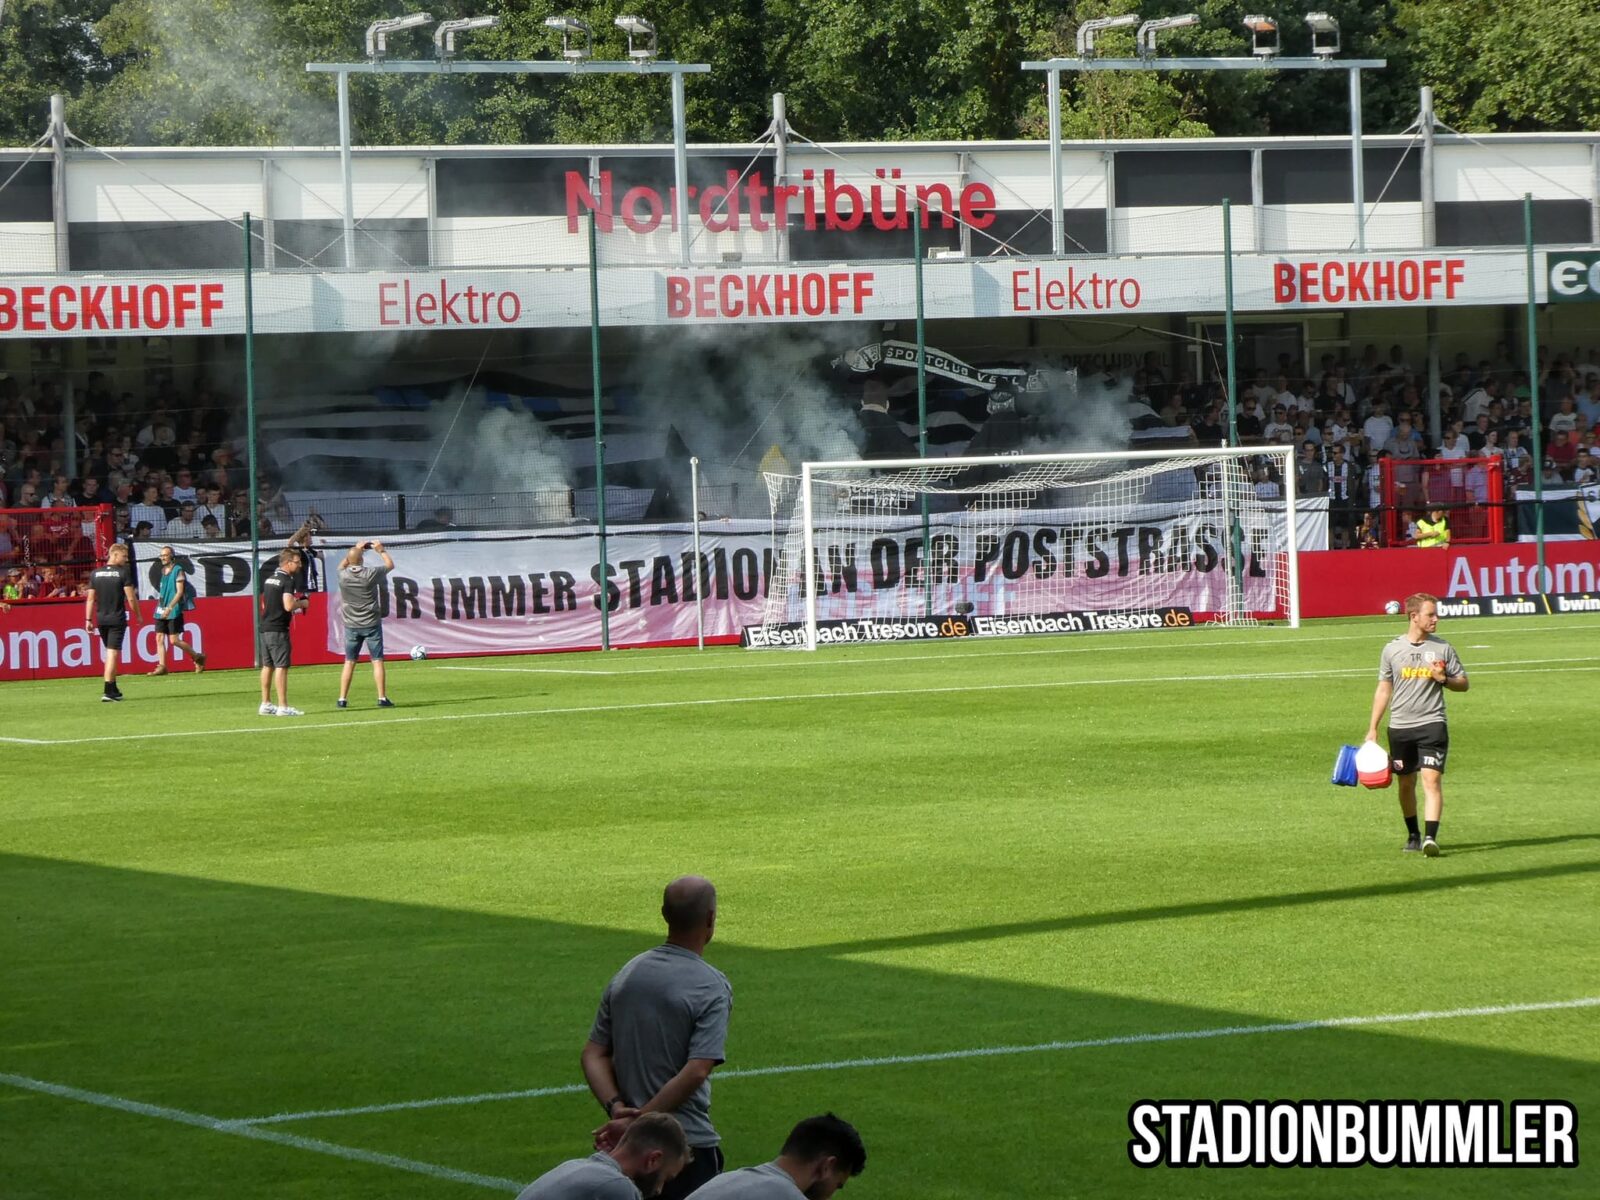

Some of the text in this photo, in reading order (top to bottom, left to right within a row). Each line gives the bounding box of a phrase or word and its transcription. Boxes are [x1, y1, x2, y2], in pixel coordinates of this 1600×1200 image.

[565, 168, 996, 234] Nordtribüne
[667, 272, 874, 318] BECKHOFF
[1012, 266, 1141, 312] Elektro
[1274, 259, 1464, 303] BECKHOFF
[0, 283, 223, 331] BECKHOFF
[379, 279, 522, 326] Elektro
[886, 346, 969, 376] SPOTCLUB
[432, 570, 577, 620] IMMER
[870, 534, 960, 590] DER
[1447, 556, 1600, 598] Autom
[1437, 599, 1480, 617] bwin
[1492, 597, 1536, 614] bwin
[1558, 594, 1600, 612] bwin
[859, 618, 966, 642] Tresore.de
[975, 608, 1190, 636] Eisenbach Tresore.de
[1410, 653, 1422, 661] TR
[1423, 755, 1435, 766] TR
